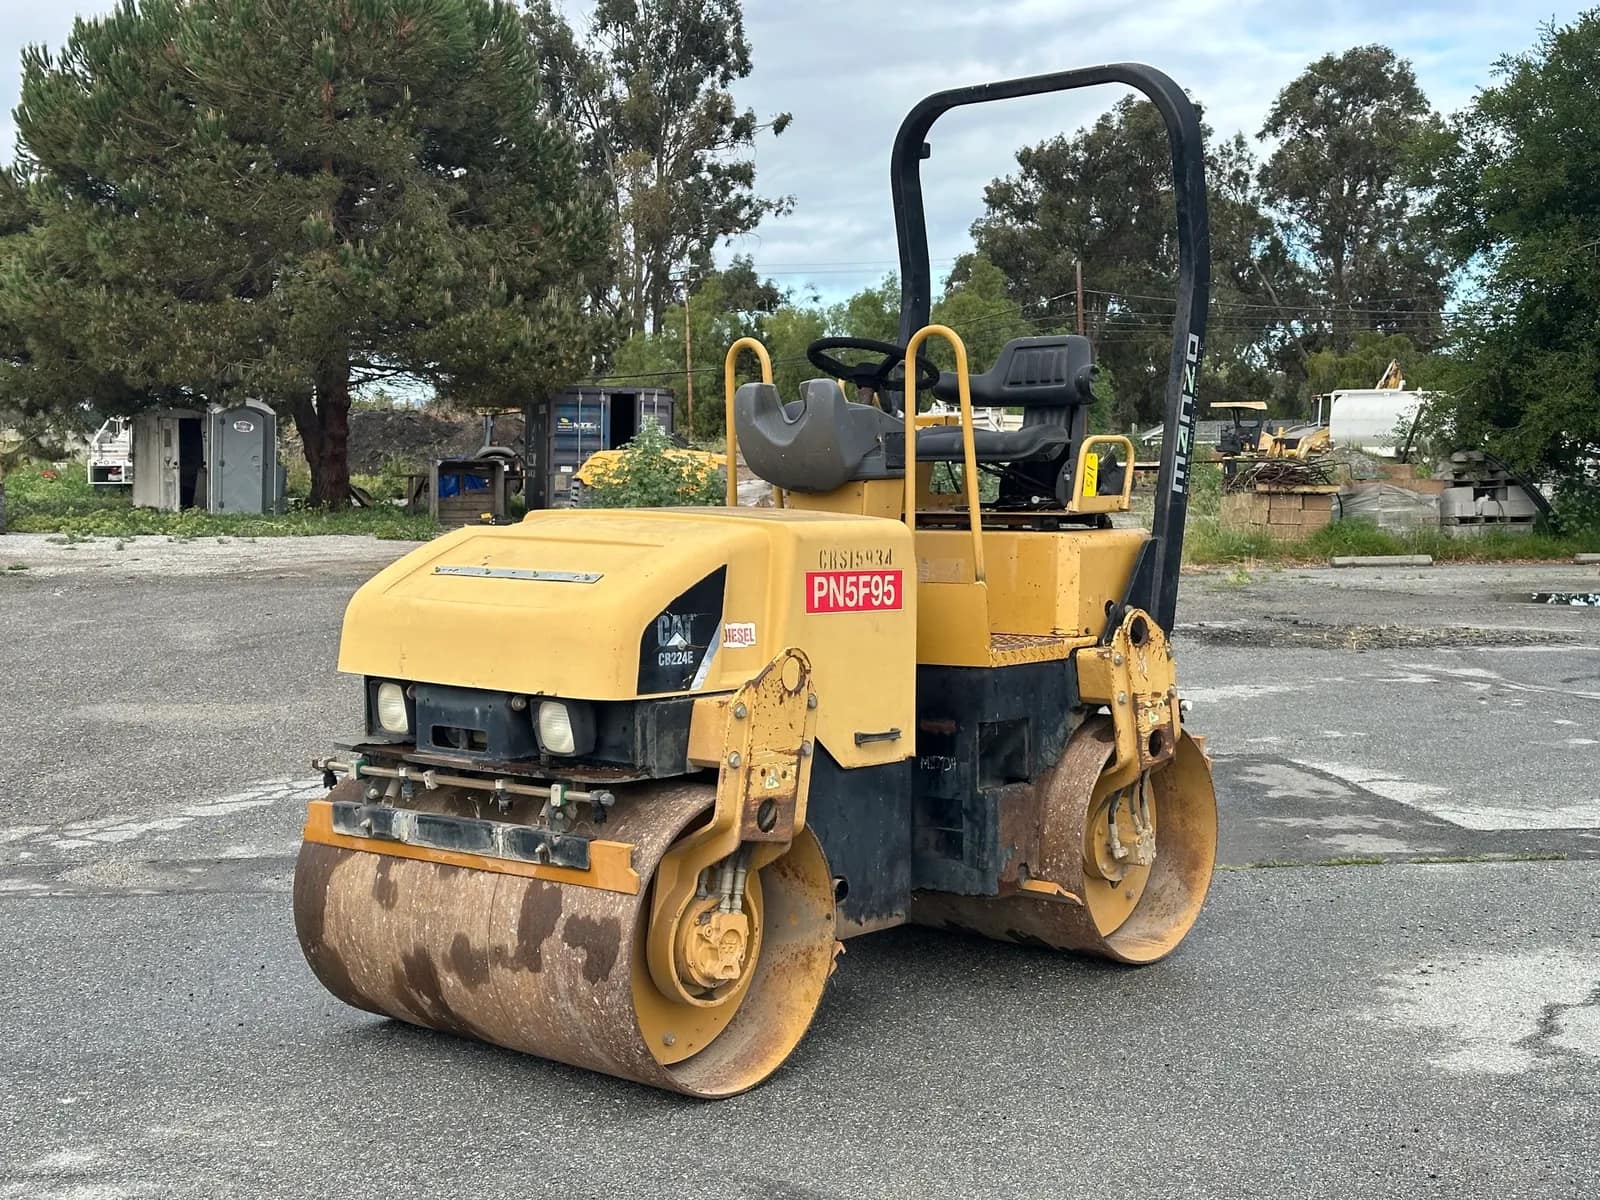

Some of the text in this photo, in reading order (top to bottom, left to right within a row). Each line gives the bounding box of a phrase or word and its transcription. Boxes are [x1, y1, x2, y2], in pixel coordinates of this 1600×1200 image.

[813, 575, 895, 608] PN5F95
[658, 614, 697, 647] CAT
[658, 650, 694, 666] CB224E
